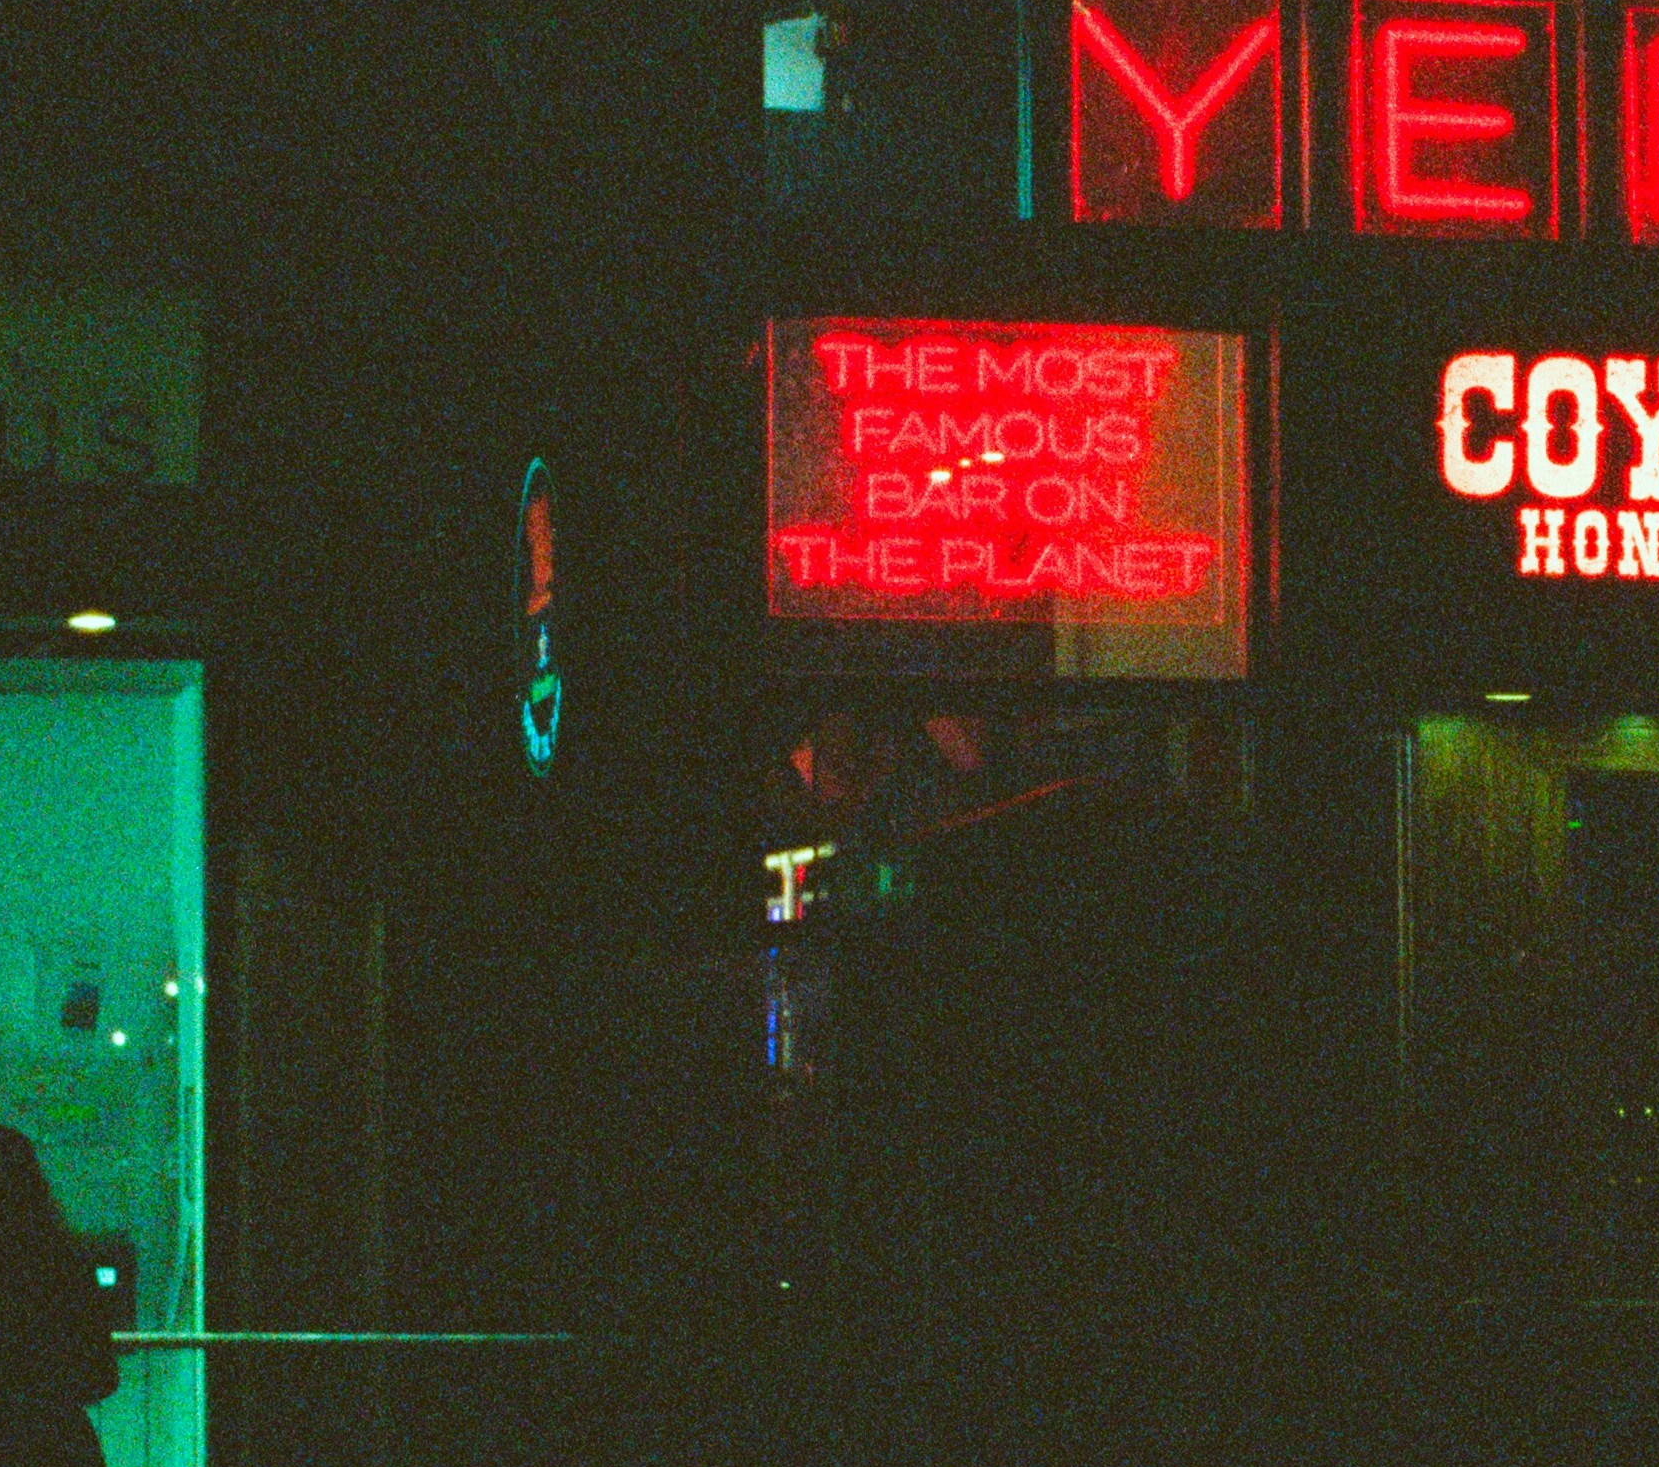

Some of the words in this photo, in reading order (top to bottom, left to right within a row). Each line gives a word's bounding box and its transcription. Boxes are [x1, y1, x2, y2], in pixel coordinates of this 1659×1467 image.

[818, 340, 961, 394] THE
[976, 344, 1180, 398] MOST
[852, 406, 1142, 462] FAMOUS
[867, 471, 1010, 521] BAR
[1024, 476, 1127, 526] ON
[777, 534, 928, 586] THE
[942, 537, 1212, 593] PLANET
